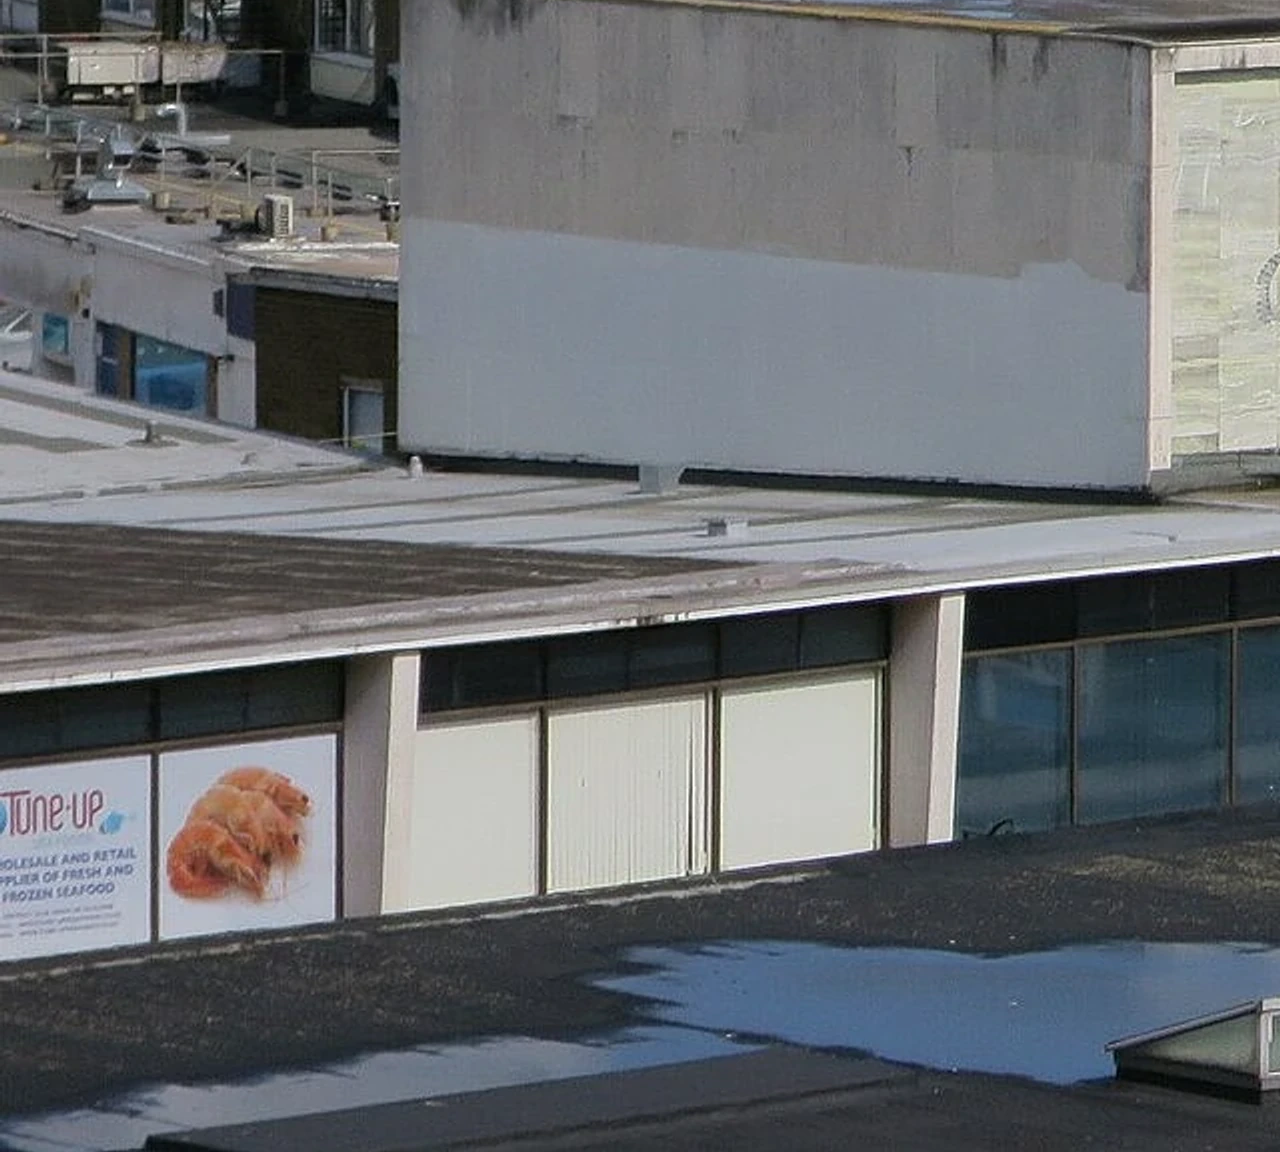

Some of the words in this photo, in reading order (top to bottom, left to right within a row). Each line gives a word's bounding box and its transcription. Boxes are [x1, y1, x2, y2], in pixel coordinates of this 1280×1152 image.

[61, 851, 91, 865] AND
[93, 847, 137, 862] RETAIL
[42, 870, 59, 883] OF
[62, 867, 101, 881] FRESH
[104, 864, 134, 877] AND
[2, 887, 53, 903] FROZEN
[56, 882, 116, 898] SEAFOOD
